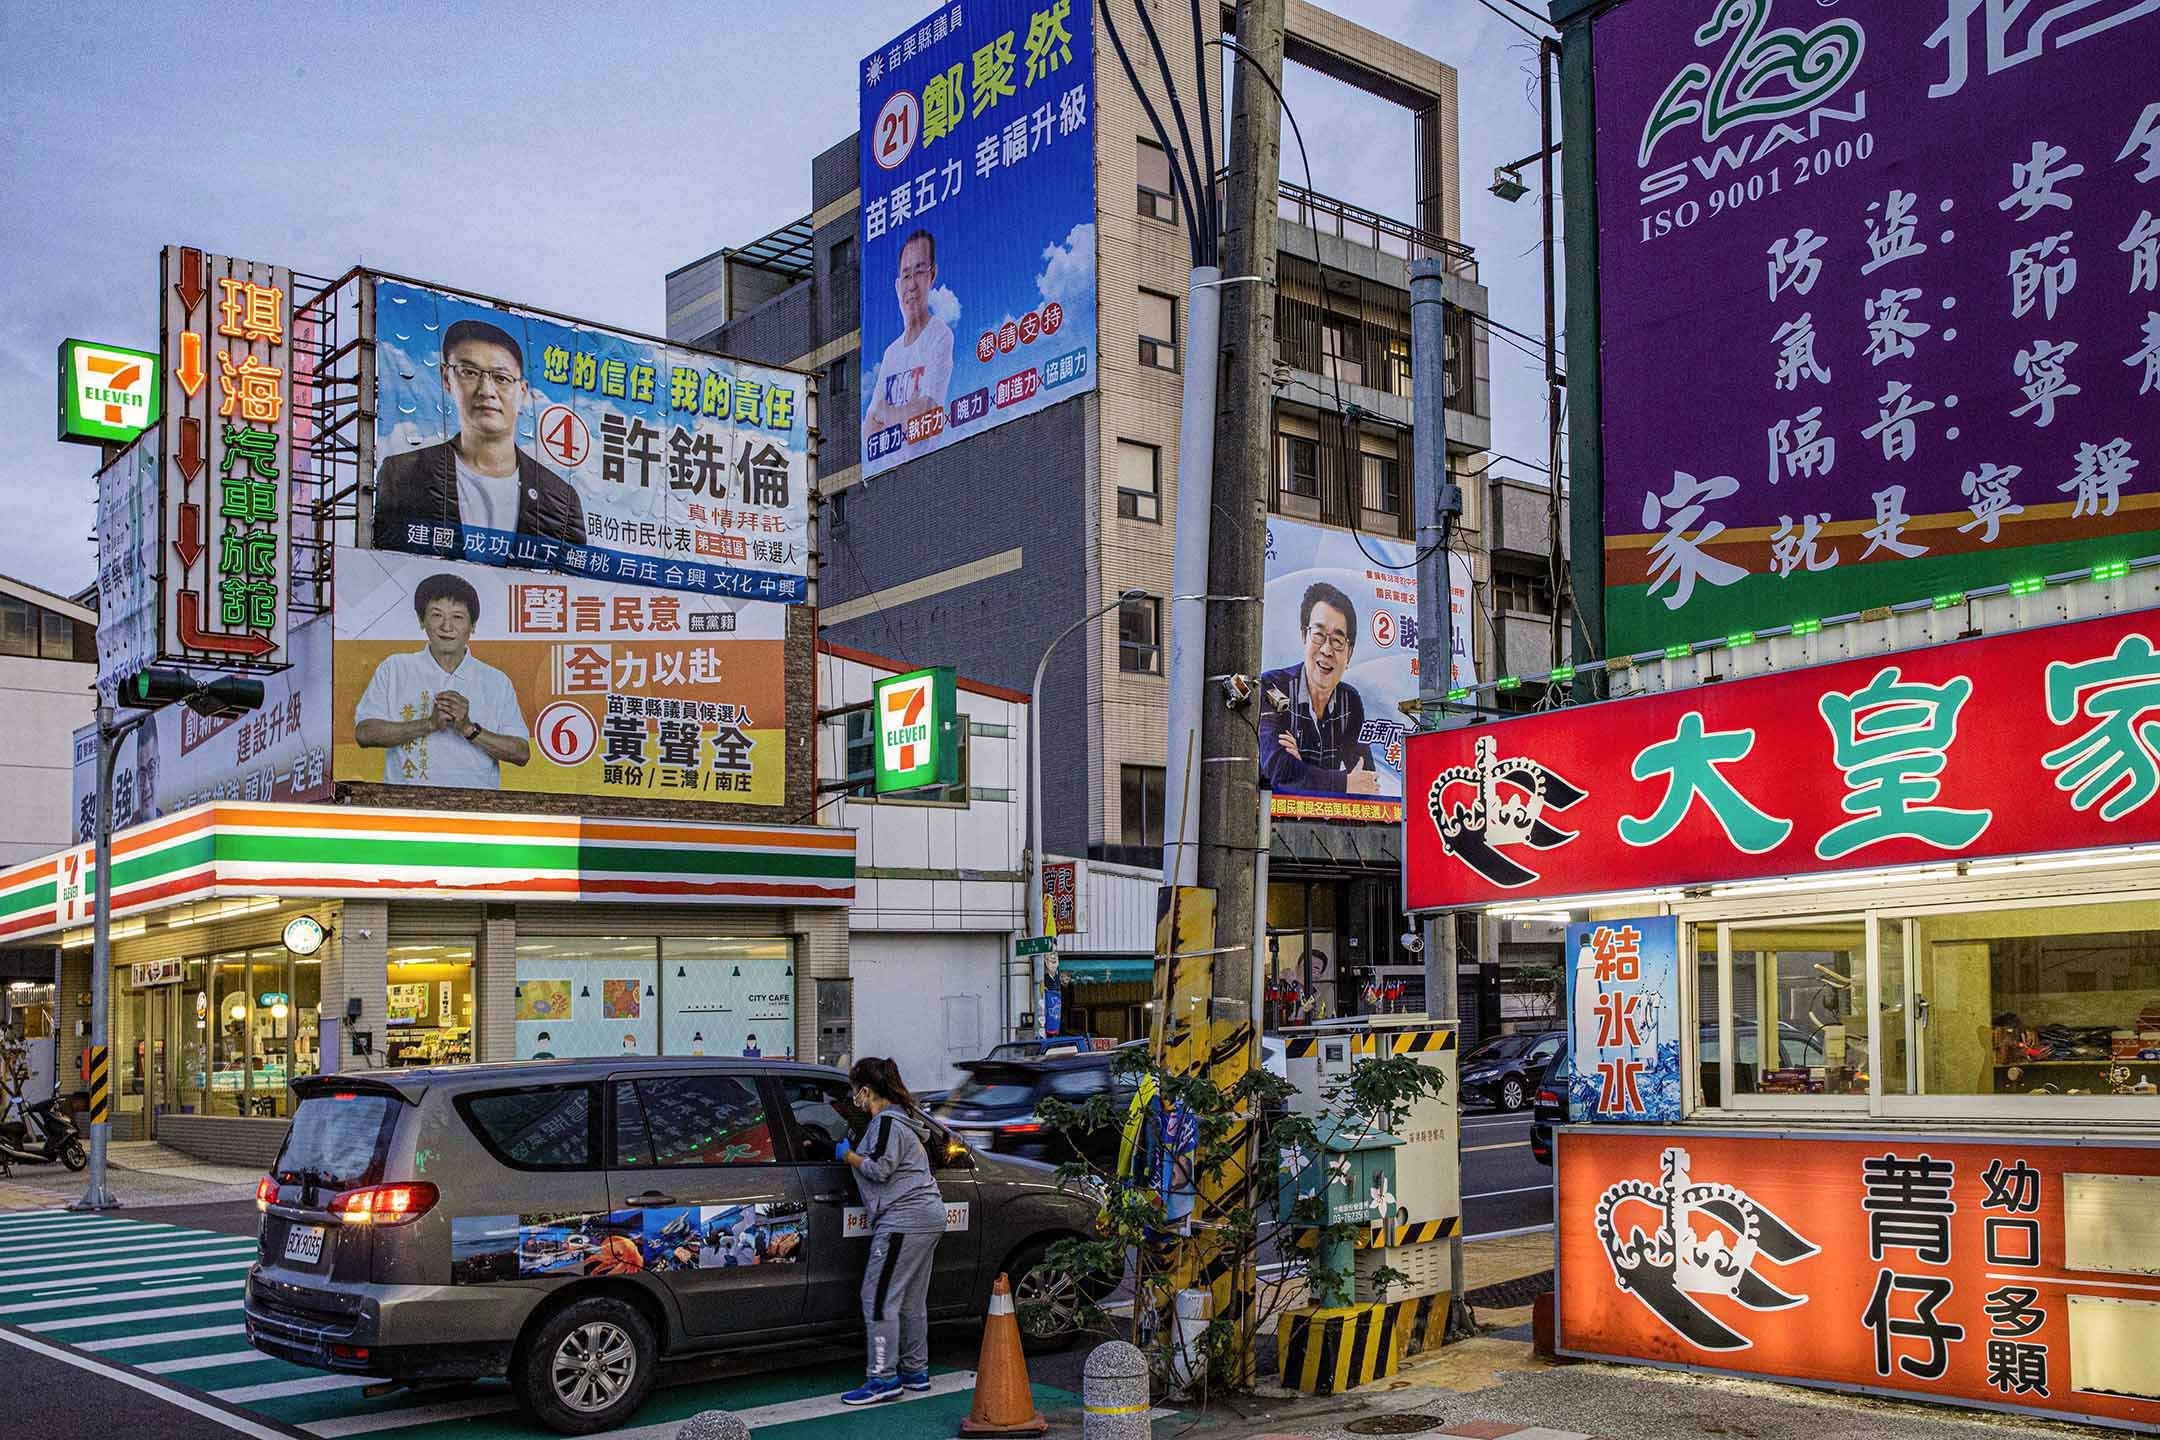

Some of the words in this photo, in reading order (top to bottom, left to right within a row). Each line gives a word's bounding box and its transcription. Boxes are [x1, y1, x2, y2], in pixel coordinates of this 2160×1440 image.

[888, 4, 963, 73] 苗栗縣議員
[922, 0, 1074, 149] 鄭聚然
[882, 104, 909, 158] 21
[975, 83, 1088, 179] 幸福升級
[1640, 90, 1866, 206] SWAN
[866, 157, 963, 241] 苗栗五力
[1640, 200, 1701, 244] ISO
[1709, 167, 1783, 219] 9001
[1794, 132, 1874, 186] 2000
[977, 303, 1063, 361] 懇請支持
[87, 356, 140, 424] 7
[542, 345, 658, 404] 您的信任
[669, 366, 795, 432] 我的責任
[868, 427, 901, 457] 行動力
[907, 410, 944, 440] 執行力
[997, 371, 1037, 404] 創造力
[1046, 352, 1086, 383] 協調力
[545, 414, 580, 462] 4
[600, 413, 791, 509] 許銑倫
[587, 511, 692, 554] 頭份市民代表
[752, 540, 797, 567] 候選人
[687, 503, 787, 534] 真情拜託
[407, 523, 455, 549] 建國
[462, 531, 511, 556] 成功
[517, 540, 559, 562] 山下
[565, 549, 611, 574] 蟠桃
[616, 557, 659, 582] 后庄
[664, 564, 707, 590] 合興
[713, 570, 752, 595] 文化
[759, 576, 796, 599] 中興
[521, 584, 681, 633] 聲言民意
[689, 613, 736, 632] 無黨籍
[1378, 616, 1390, 639] 2
[565, 645, 722, 694] 全力以赴
[236, 691, 302, 767] 建設升級
[551, 713, 580, 756] 6
[603, 718, 755, 771] 黃聲全
[606, 695, 754, 726] 苗栗縣議員候選人
[888, 685, 925, 770] 7
[1617, 633, 2160, 862] 大皇家
[748, 994, 767, 1002] CITY
[768, 994, 790, 1002] CAFE
[1980, 1157, 2042, 1268] 幼口
[1862, 1152, 1966, 1380] 菁仔
[1984, 1286, 2052, 1399] 多顆
